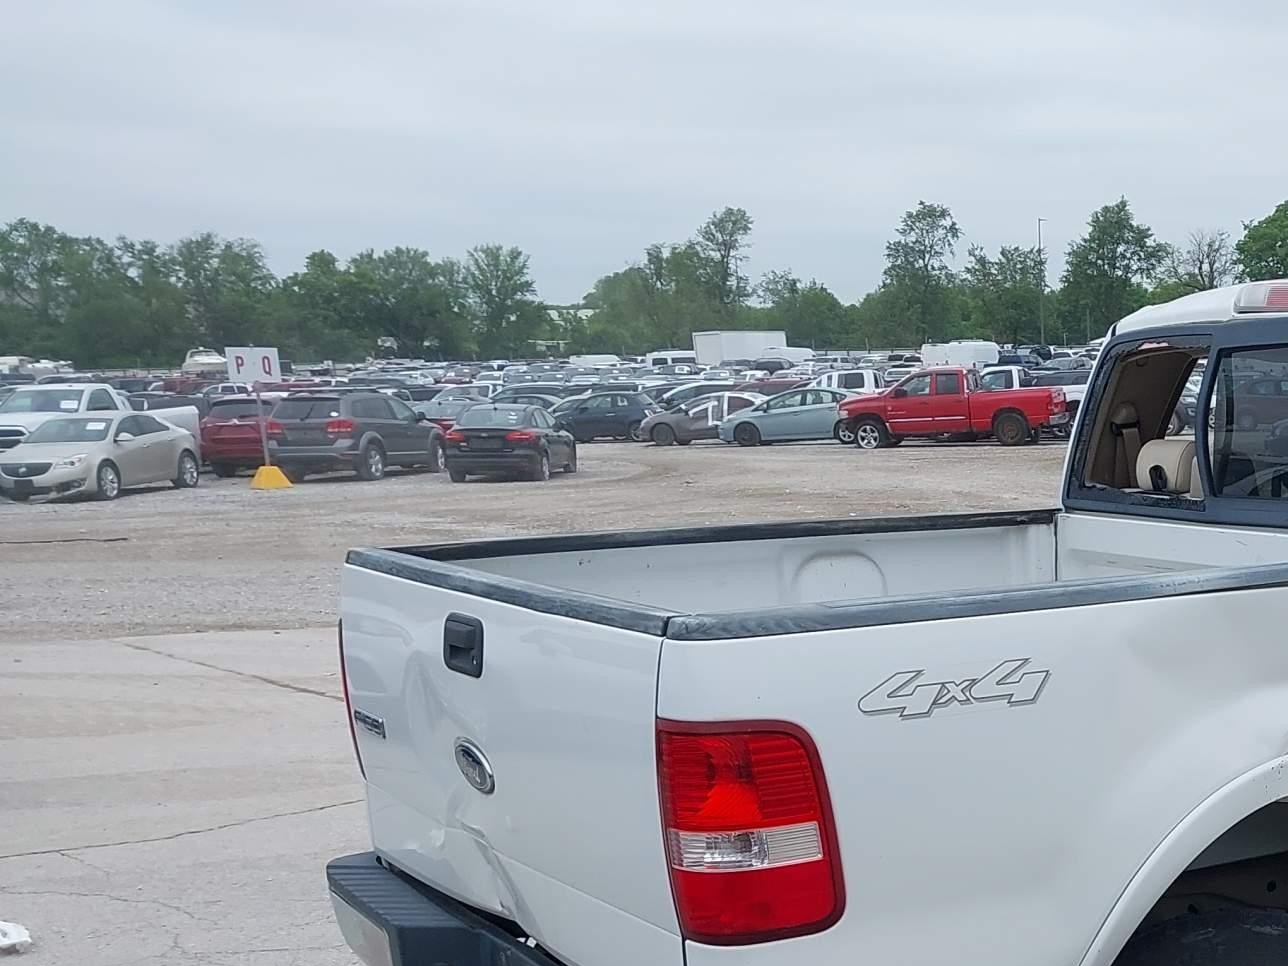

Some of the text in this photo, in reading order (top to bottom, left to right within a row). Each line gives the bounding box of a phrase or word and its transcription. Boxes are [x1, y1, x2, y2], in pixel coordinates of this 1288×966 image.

[235, 355, 273, 377] P Q
[857, 657, 1052, 721] 4x4
